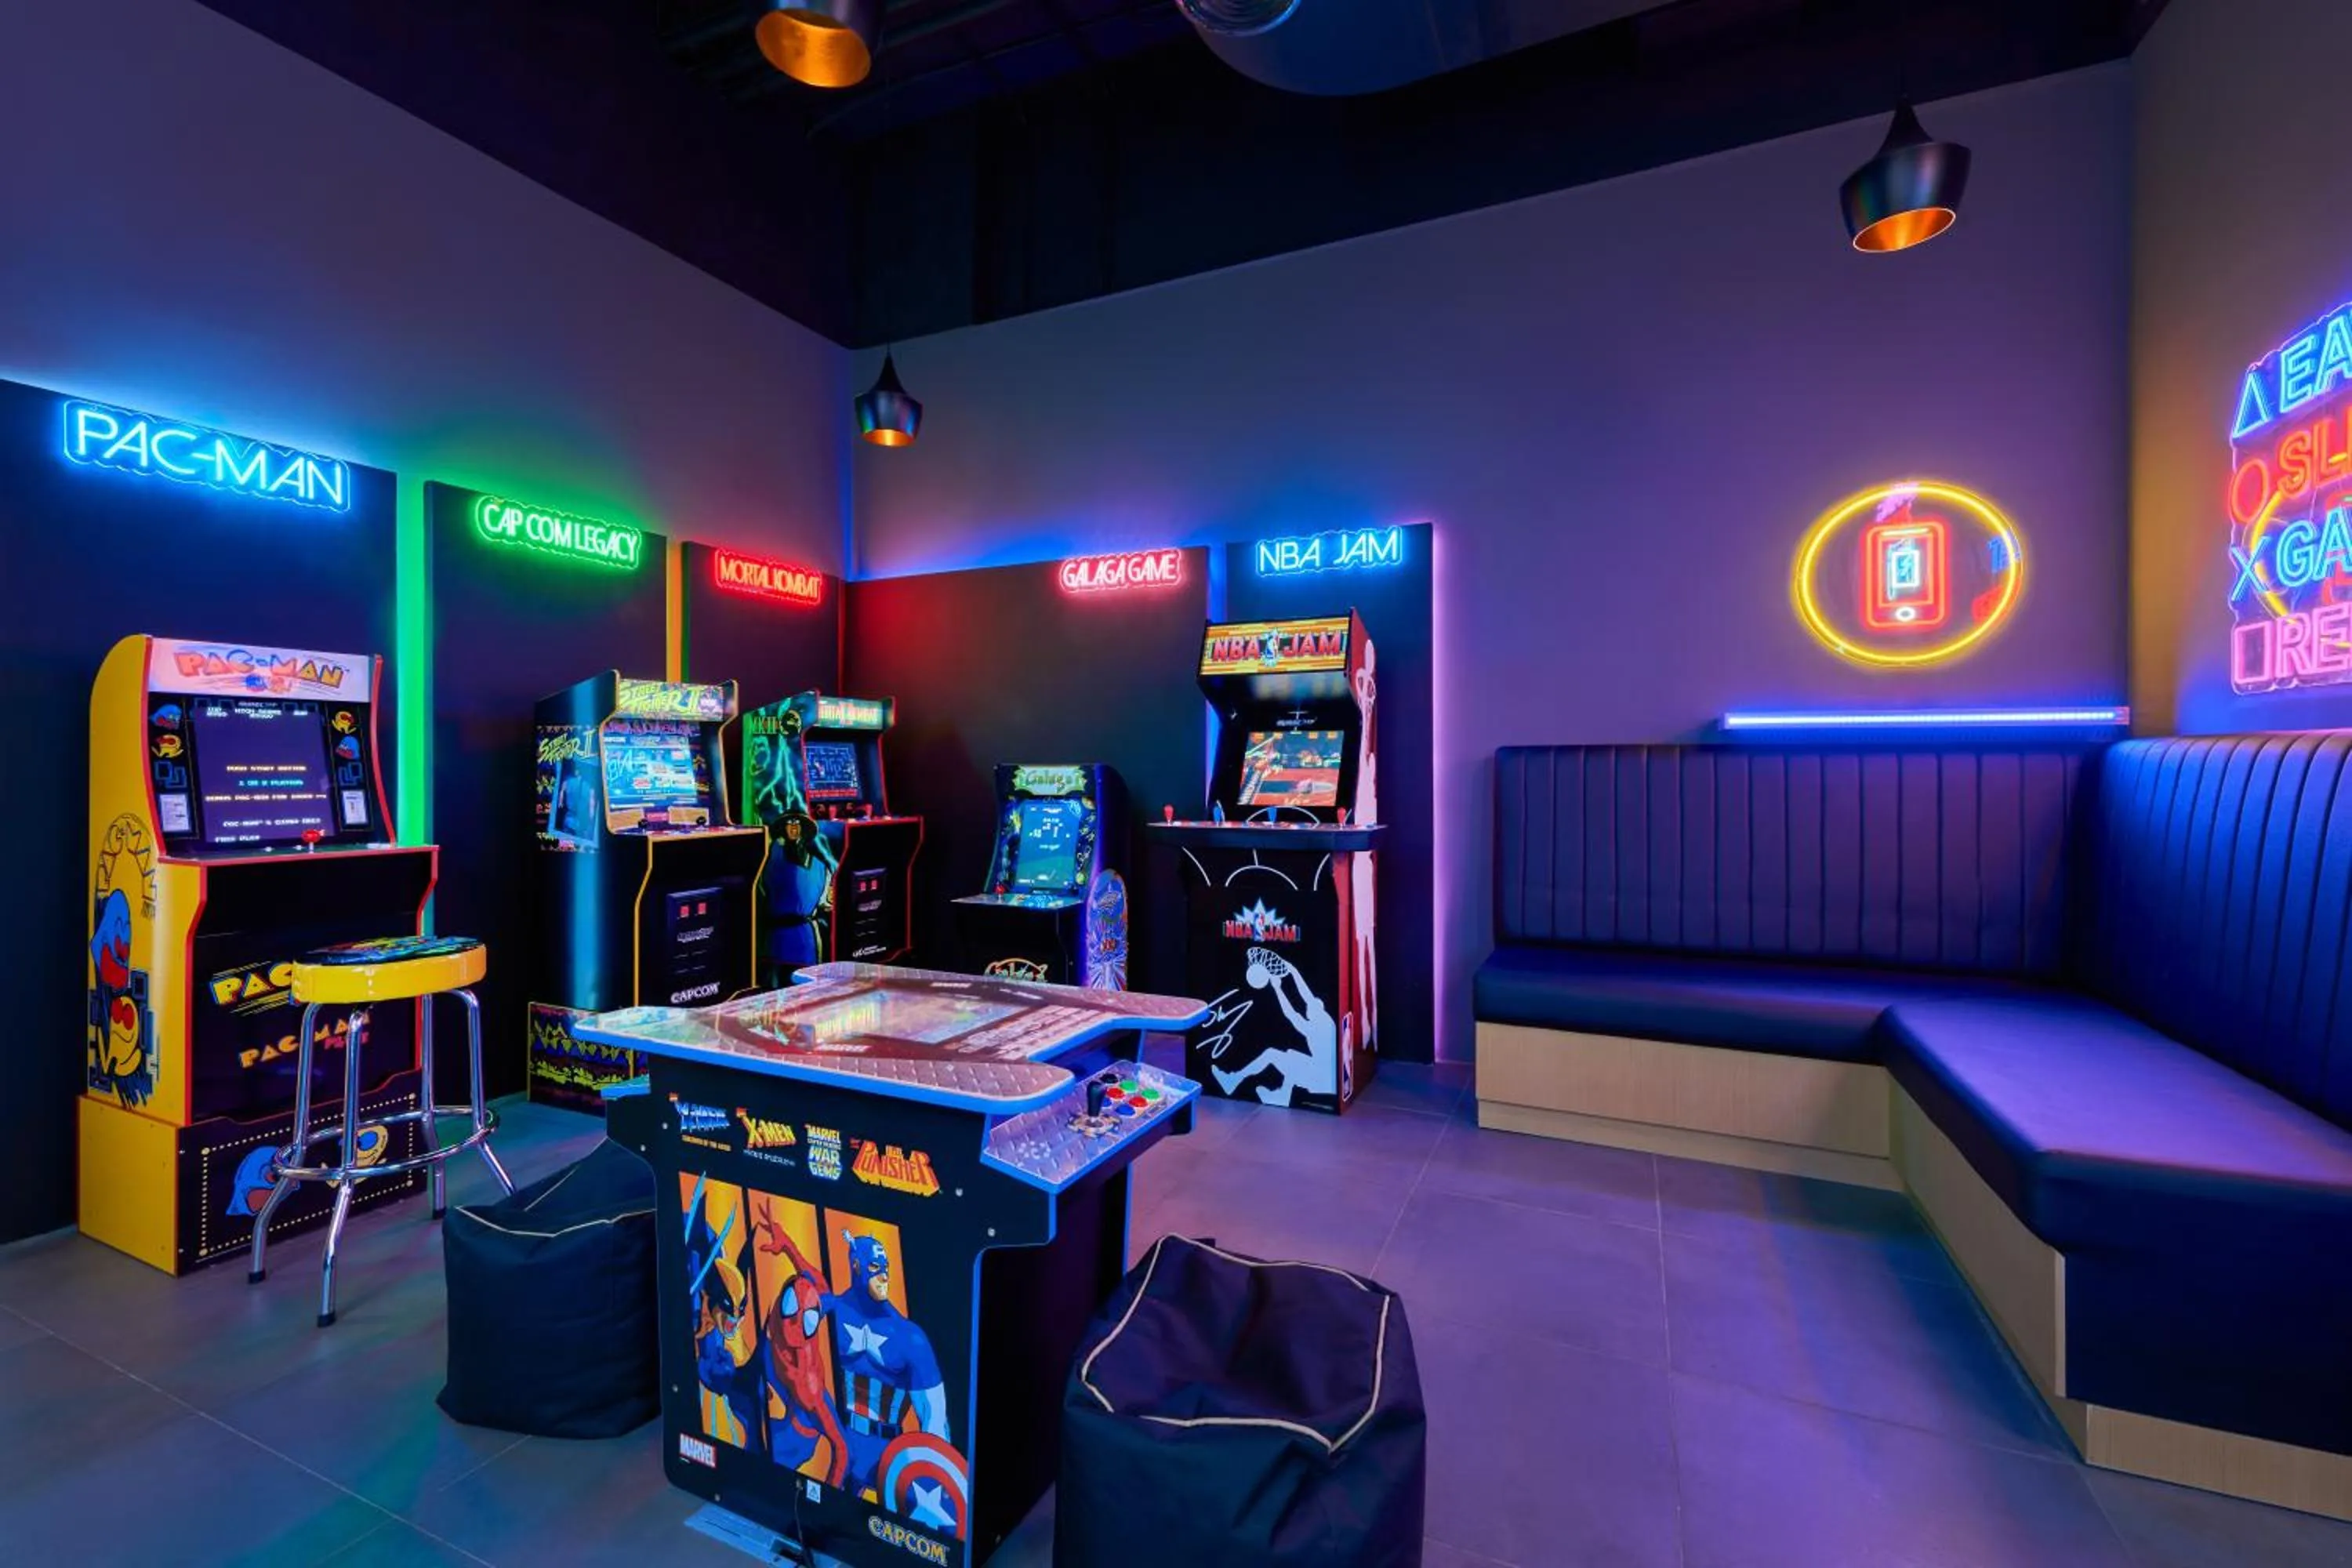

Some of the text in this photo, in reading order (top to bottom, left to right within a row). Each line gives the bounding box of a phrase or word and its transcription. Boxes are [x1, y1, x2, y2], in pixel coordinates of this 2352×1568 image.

[2279, 310, 2352, 414] EA
[77, 408, 344, 505] PAC-MAN
[2277, 406, 2352, 498] SL
[483, 503, 638, 563] CAP COM LEGACY
[1259, 529, 1398, 572] NBA JAM
[720, 555, 820, 598] MORTAL KOMBAT
[1062, 553, 1177, 587] GALAGA GAME
[1212, 629, 1341, 662] NBA JAM
[2275, 601, 2352, 680] RE
[174, 648, 344, 688] PAC-MAN
[1225, 920, 1298, 942] NBA JAM
[671, 983, 720, 1004] CAPCOM
[808, 1145, 840, 1166] WAR
[852, 1140, 940, 1197] PUNISHER
[681, 1434, 716, 1468] MARVEL
[868, 1515, 949, 1567] CAPCOM
